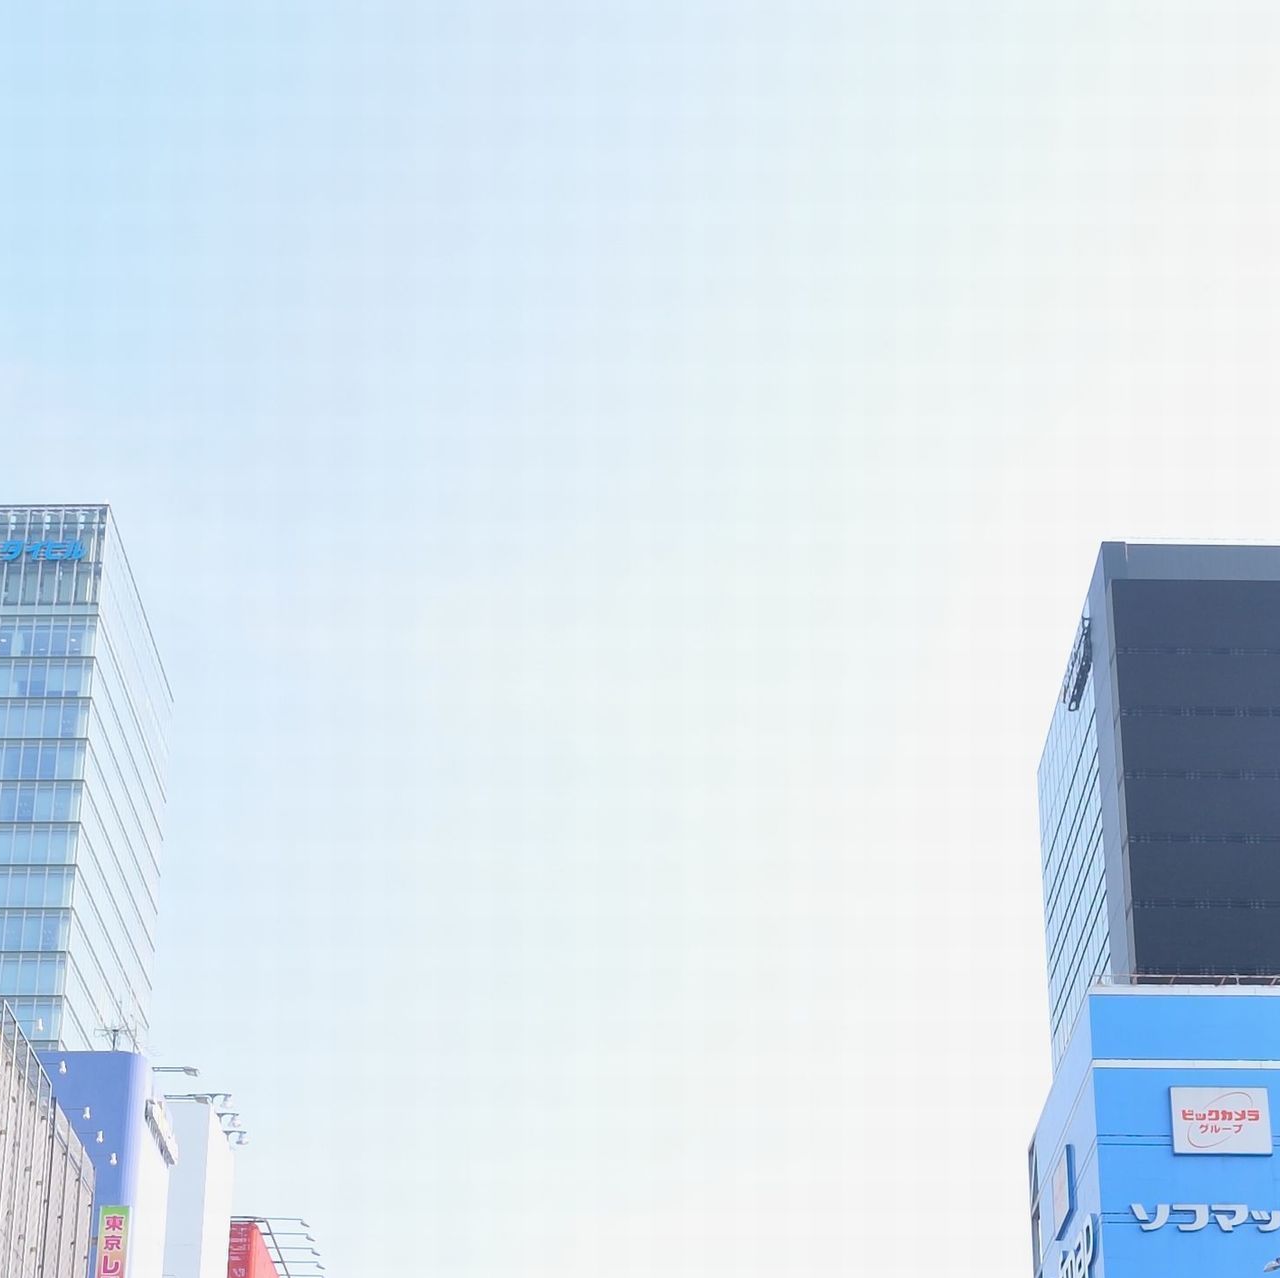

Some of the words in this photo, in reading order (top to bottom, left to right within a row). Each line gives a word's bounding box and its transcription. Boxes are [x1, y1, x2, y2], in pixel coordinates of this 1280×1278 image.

[1181, 1109, 1260, 1123] ビックカメラ
[1198, 1122, 1244, 1136] グループ
